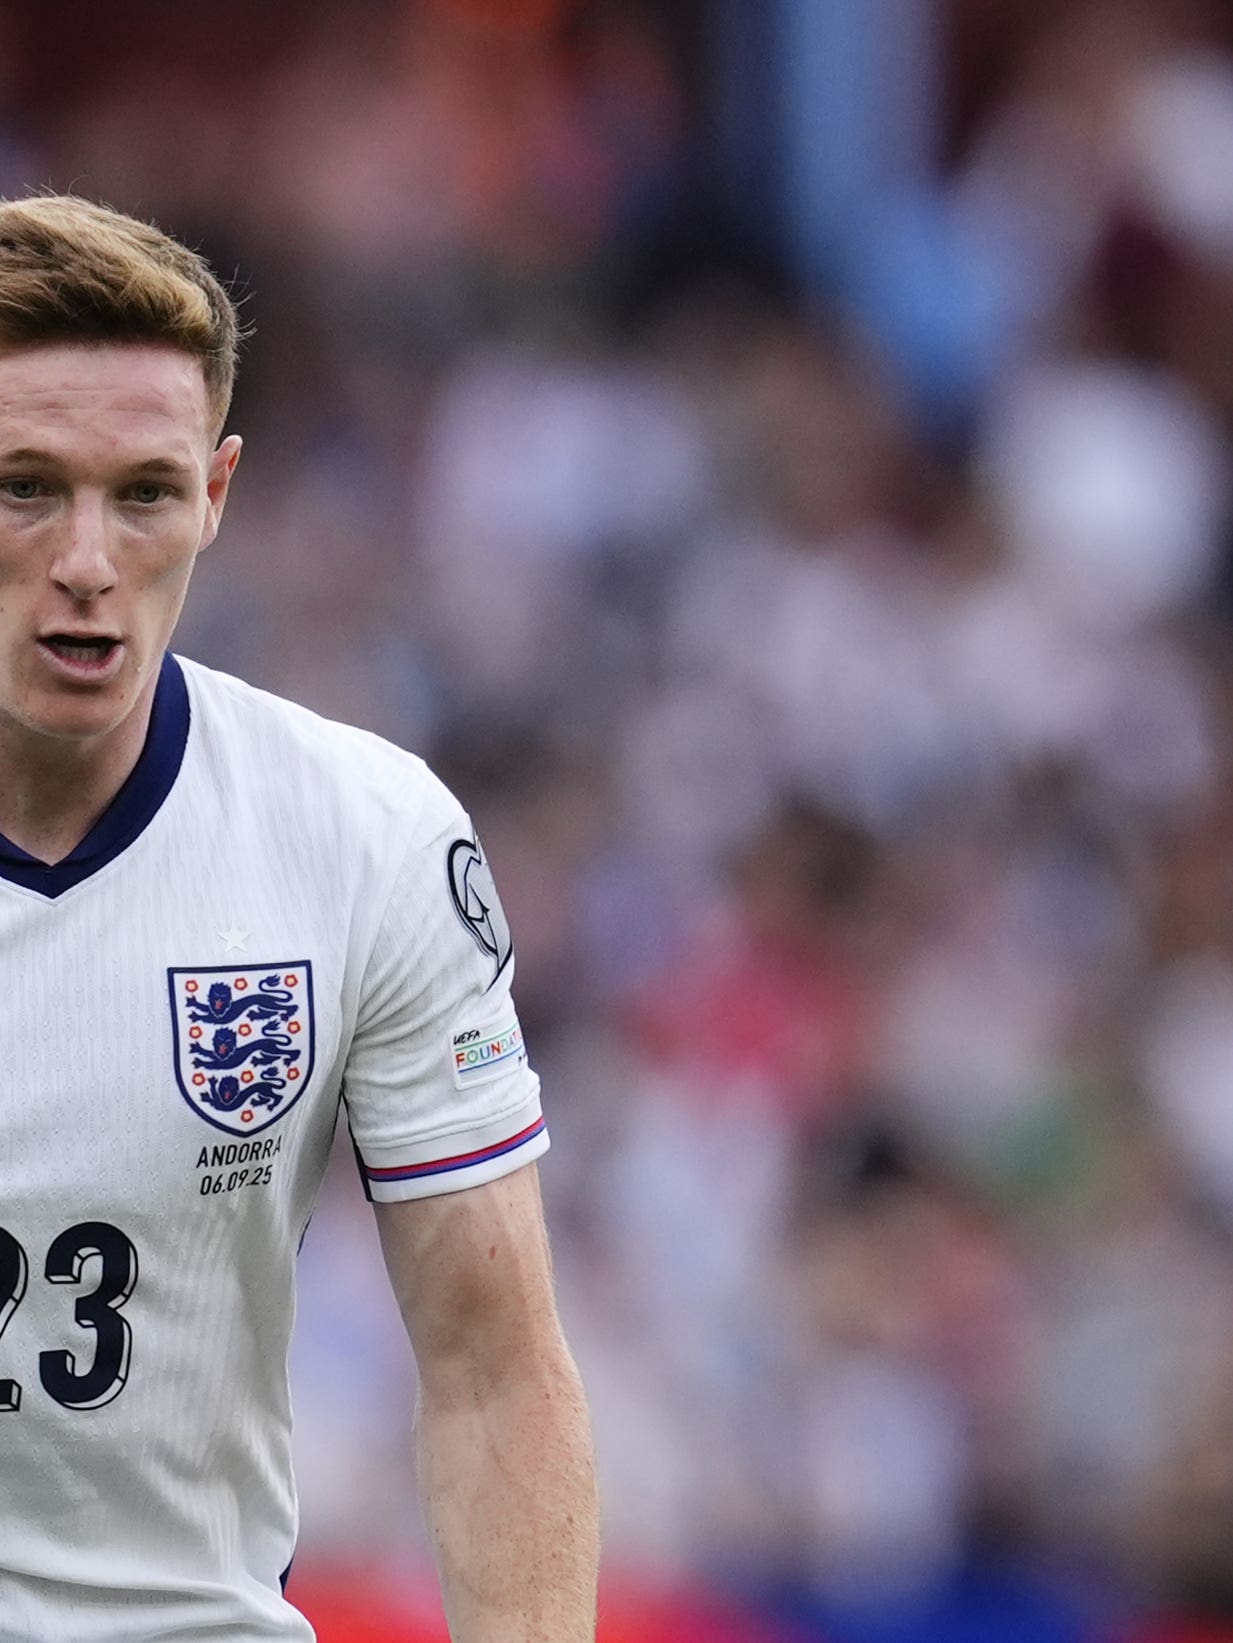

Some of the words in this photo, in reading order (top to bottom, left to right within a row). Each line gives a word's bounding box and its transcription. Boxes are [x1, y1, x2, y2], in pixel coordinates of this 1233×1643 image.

[453, 1029, 481, 1046] UEFA
[196, 1135, 282, 1169] ANDORRA
[199, 1164, 273, 1195] 06.09.25
